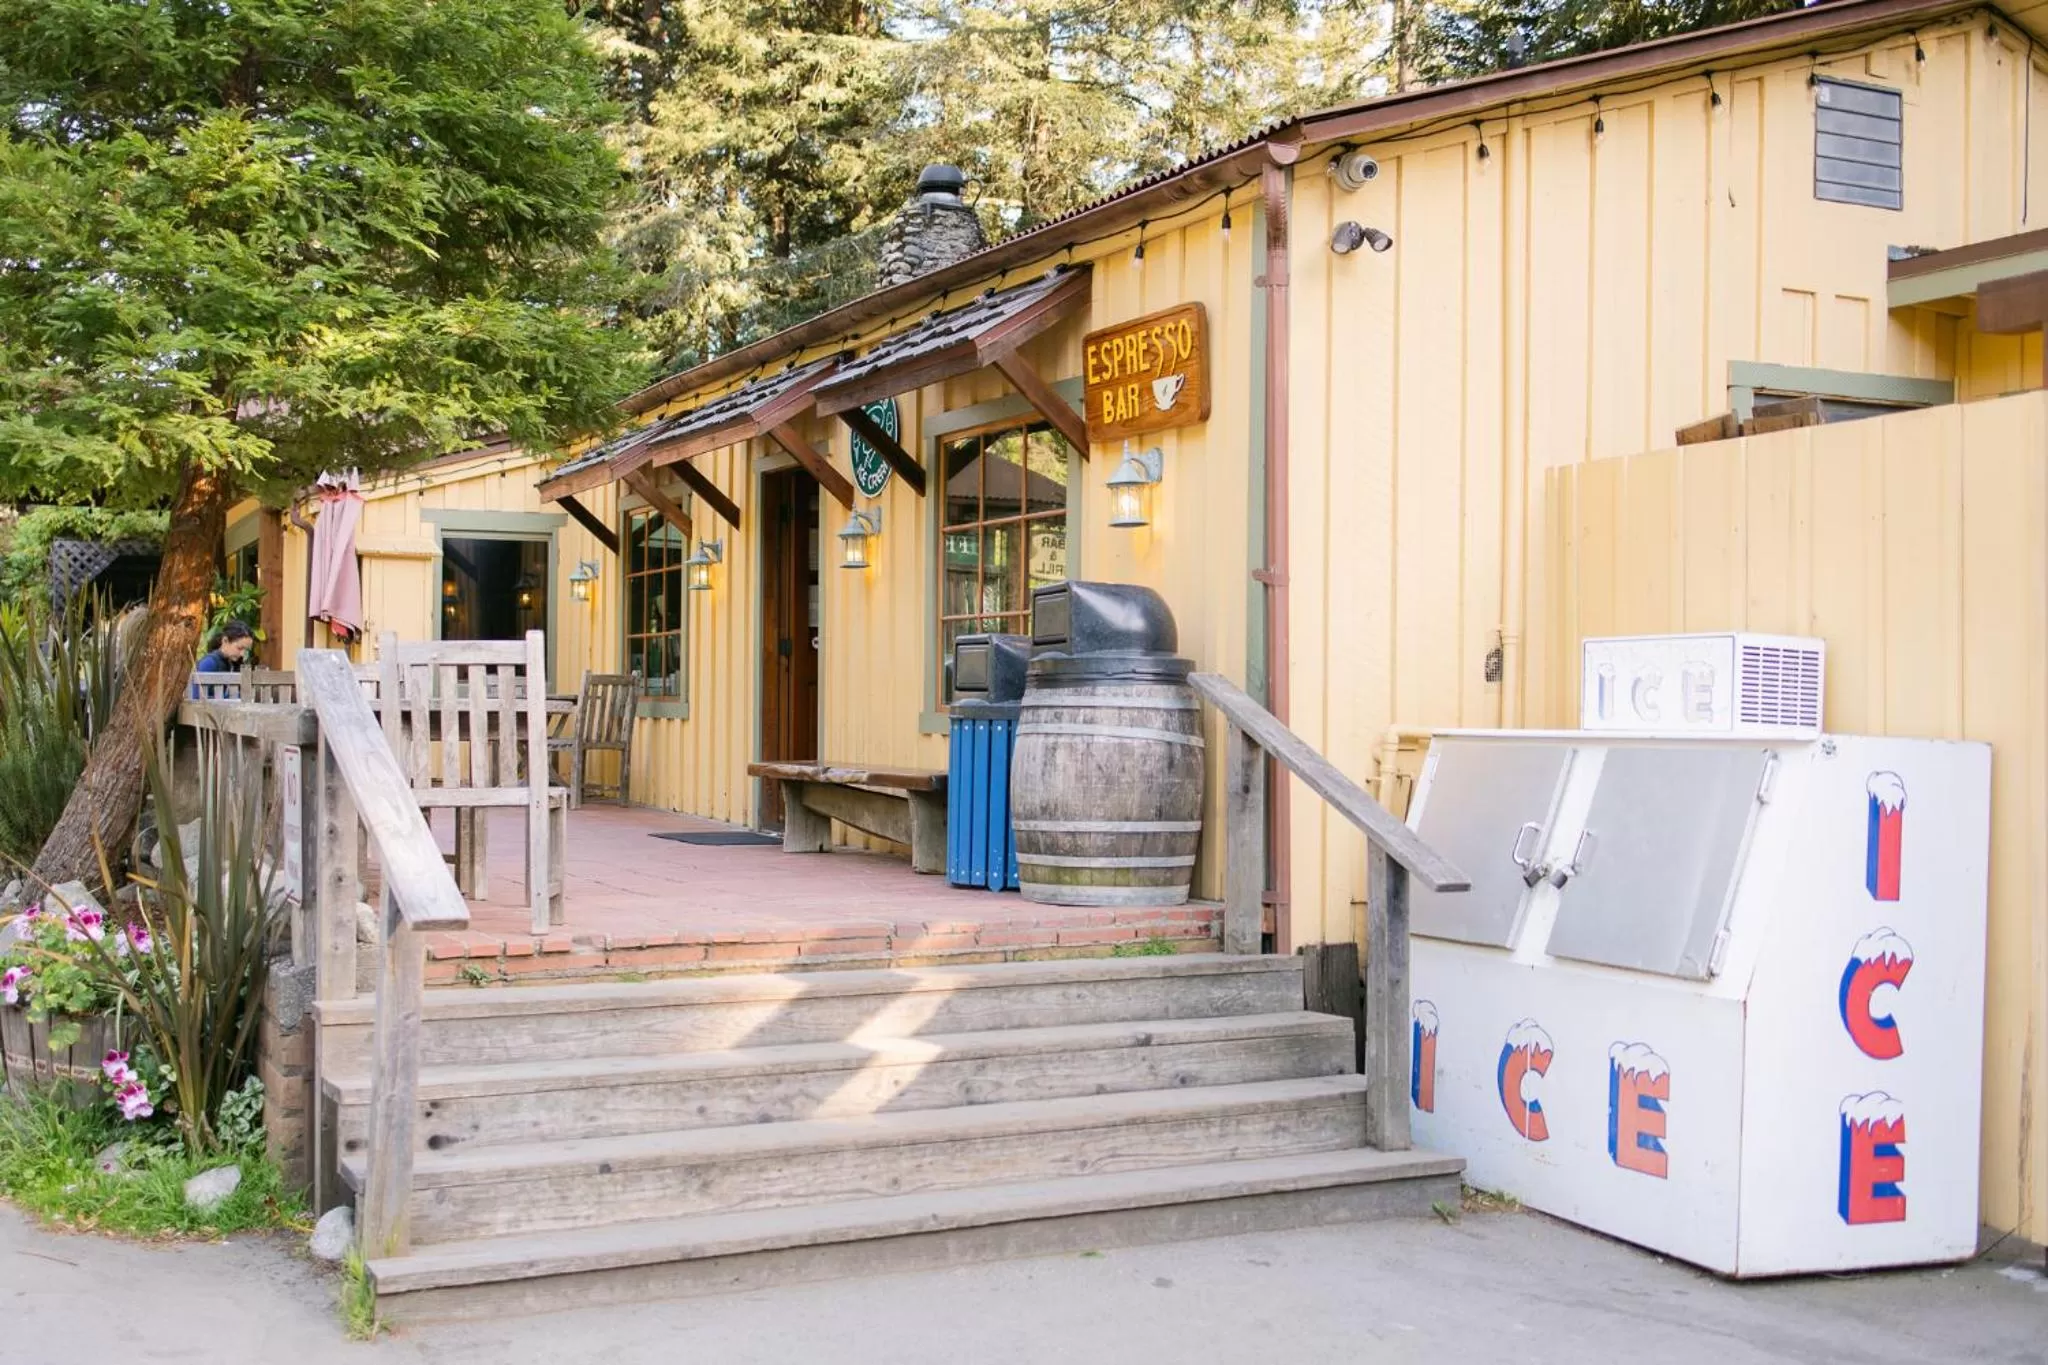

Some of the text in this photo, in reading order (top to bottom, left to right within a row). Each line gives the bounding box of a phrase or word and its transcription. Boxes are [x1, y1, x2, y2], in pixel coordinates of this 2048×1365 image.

[1087, 318, 1193, 385] ESPRESSO
[1102, 383, 1140, 425] BAR
[1596, 661, 1716, 724] ICE
[1838, 771, 1914, 1225] ICE
[1411, 999, 1671, 1180] ICE
